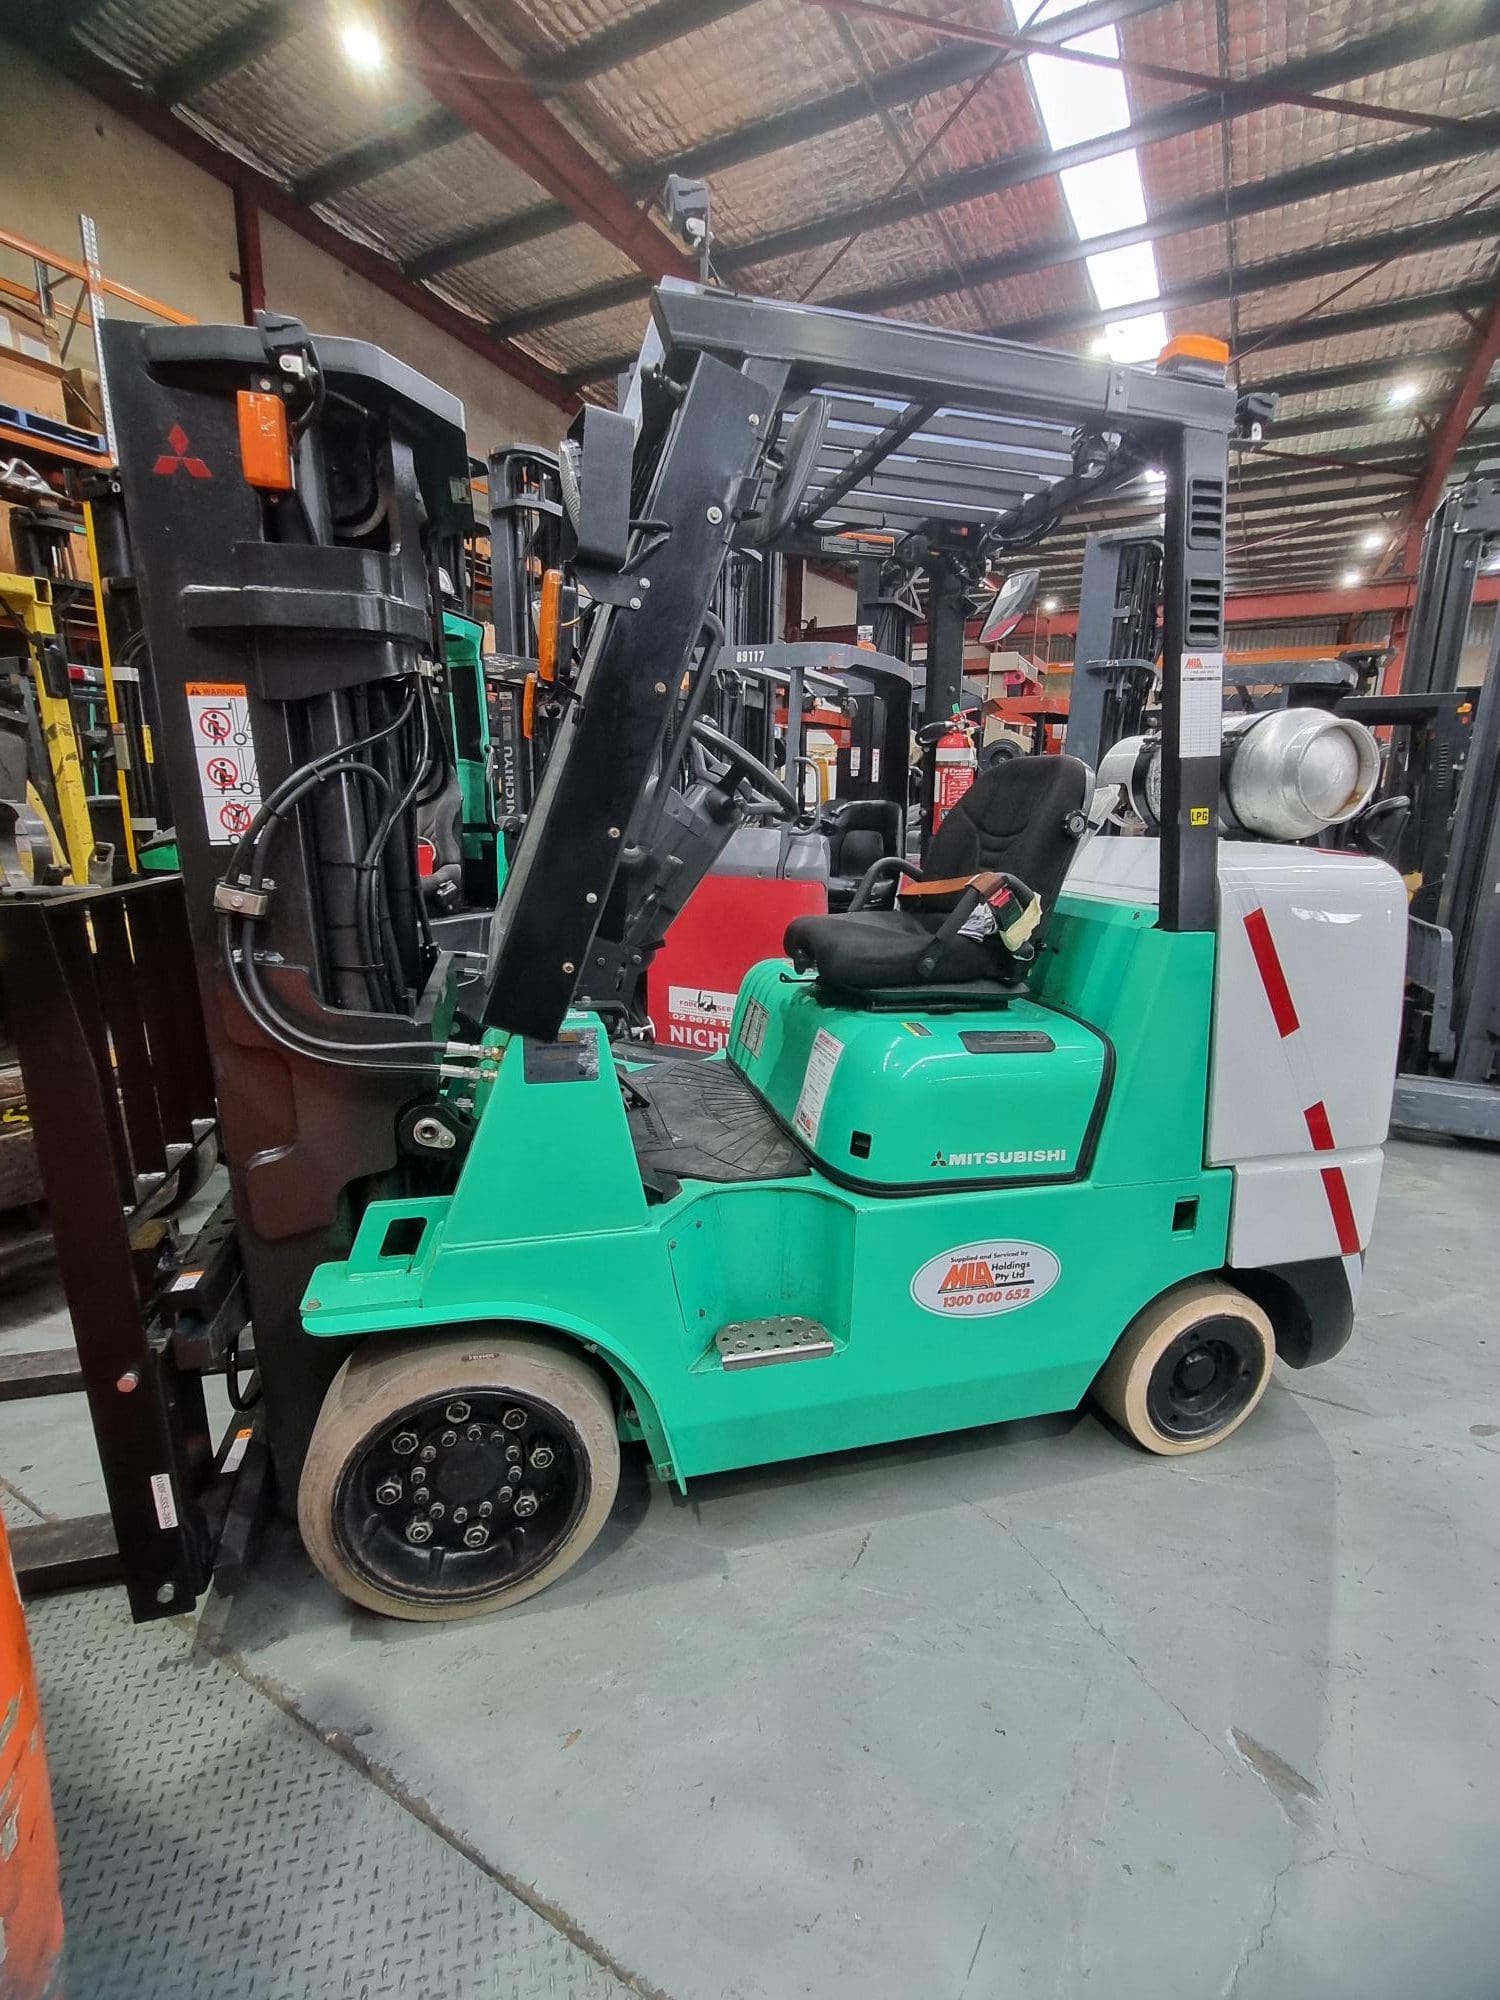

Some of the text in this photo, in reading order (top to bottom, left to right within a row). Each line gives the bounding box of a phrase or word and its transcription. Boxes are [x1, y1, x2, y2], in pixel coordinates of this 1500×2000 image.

[737, 650, 765, 663] 89117
[202, 687, 244, 696] WARNING
[503, 745, 516, 815] NICHIYU
[1191, 811, 1208, 822] LPG
[672, 1013, 686, 1021] 02
[949, 1150, 1067, 1166] MITSUBISHI
[950, 1254, 978, 1263] Supplied
[993, 1251, 1020, 1259] Serviced
[991, 1260, 1031, 1272] Holdings
[939, 1261, 995, 1290] MLA
[995, 1270, 1026, 1282] Pty Ltd
[943, 1288, 1031, 1308] 1300 000 652
